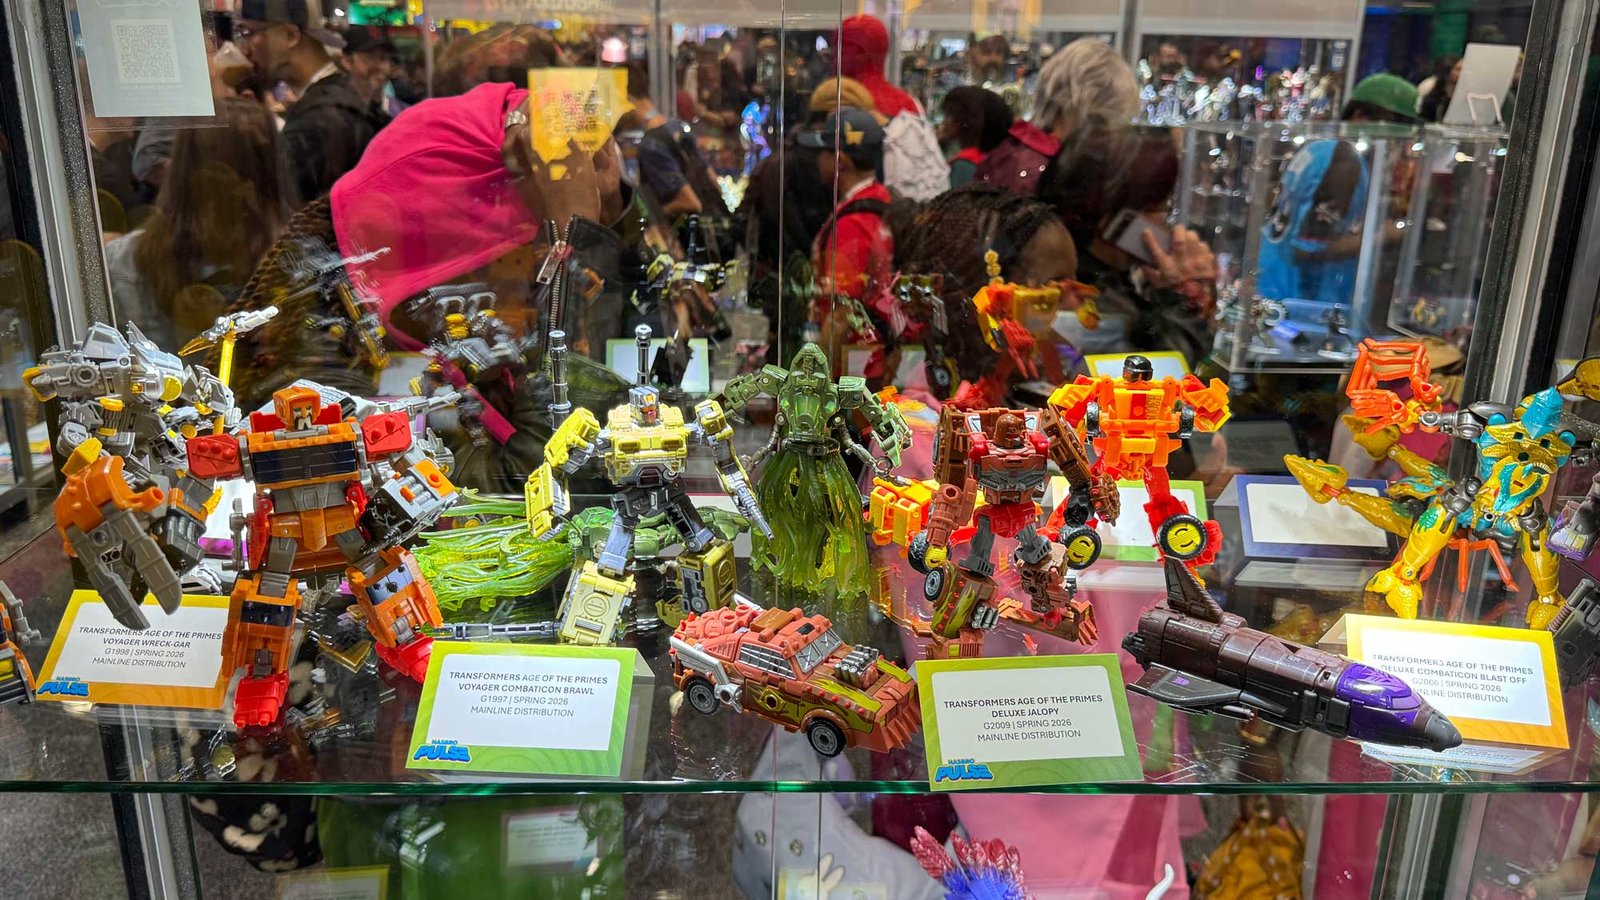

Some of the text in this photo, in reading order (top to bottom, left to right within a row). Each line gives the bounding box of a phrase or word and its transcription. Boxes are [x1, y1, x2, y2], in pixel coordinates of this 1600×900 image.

[80, 626, 143, 636] TRANSFORMERS
[192, 632, 222, 640] PRIMES
[103, 638, 190, 648] VOYAGER WRECK-GAR
[135, 649, 164, 657] SPRING
[132, 659, 187, 668] DISTRIBUTION
[1446, 661, 1464, 669] AGE
[1499, 666, 1533, 675] PRIMES
[450, 672, 520, 681] TRANSFORMERS
[574, 676, 608, 684] PRIMES
[1381, 665, 1415, 674] DELUXE
[1417, 668, 1478, 679] COMBATICON
[1480, 674, 1507, 682] BLAST
[38, 682, 88, 695] PULSE
[459, 683, 499, 691] VOYAGER
[501, 685, 561, 693] COMBATICON
[1446, 681, 1479, 690] SPRING
[1480, 684, 1501, 692] 2026
[944, 699, 1016, 708] TRANSFORMERS
[1069, 695, 1103, 703] PRIMES
[1447, 692, 1508, 703] DISTRIBUTION
[471, 706, 574, 717] MAINLINE DISTRIBUTION
[992, 708, 1059, 717] DELUXE JALOPY
[983, 721, 1011, 729] G2009
[1017, 720, 1049, 728] SPRING
[1051, 719, 1071, 727] 2026
[978, 730, 1081, 741] MAINLINE DISTRIBUTION
[414, 745, 470, 761] PULSE
[936, 765, 992, 782] PULSE
